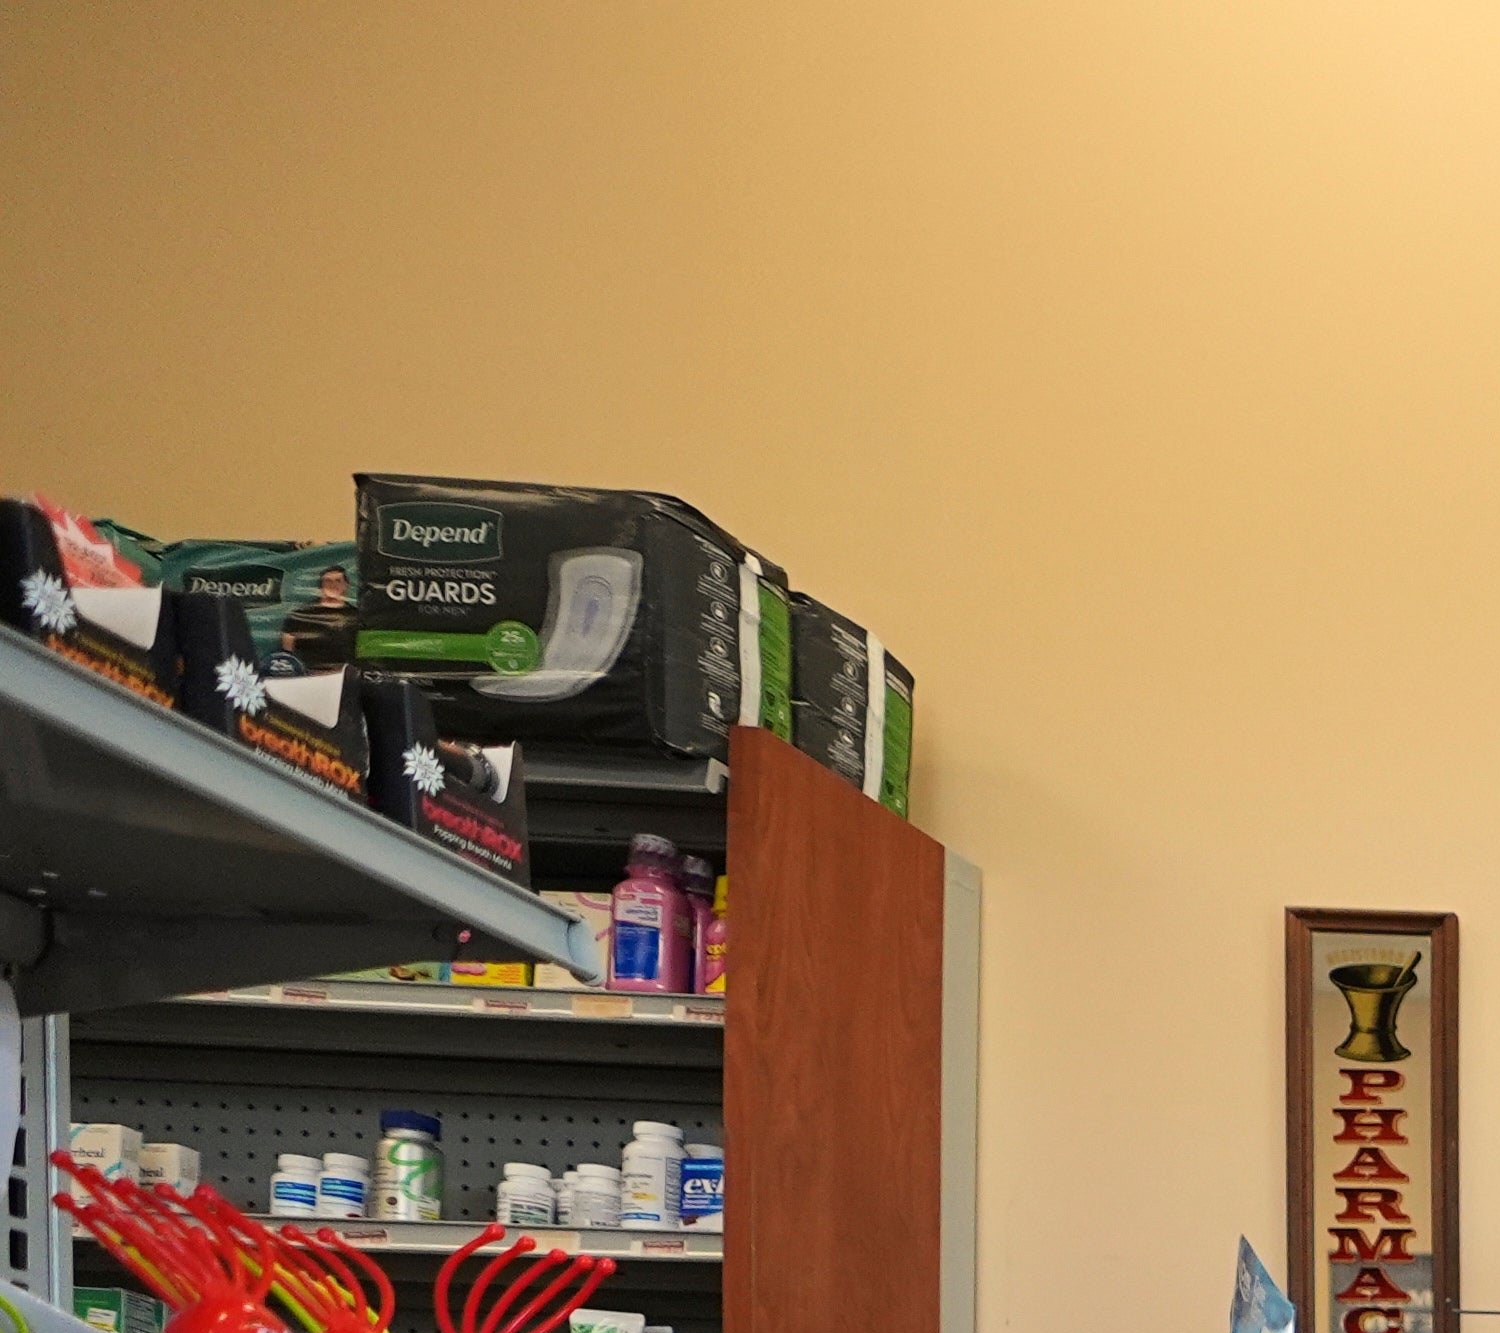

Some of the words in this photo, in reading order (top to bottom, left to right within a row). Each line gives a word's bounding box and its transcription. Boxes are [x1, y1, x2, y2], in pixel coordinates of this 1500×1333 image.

[393, 518, 488, 547] Depend
[190, 576, 273, 599] Depend
[386, 580, 497, 605] GUARDS
